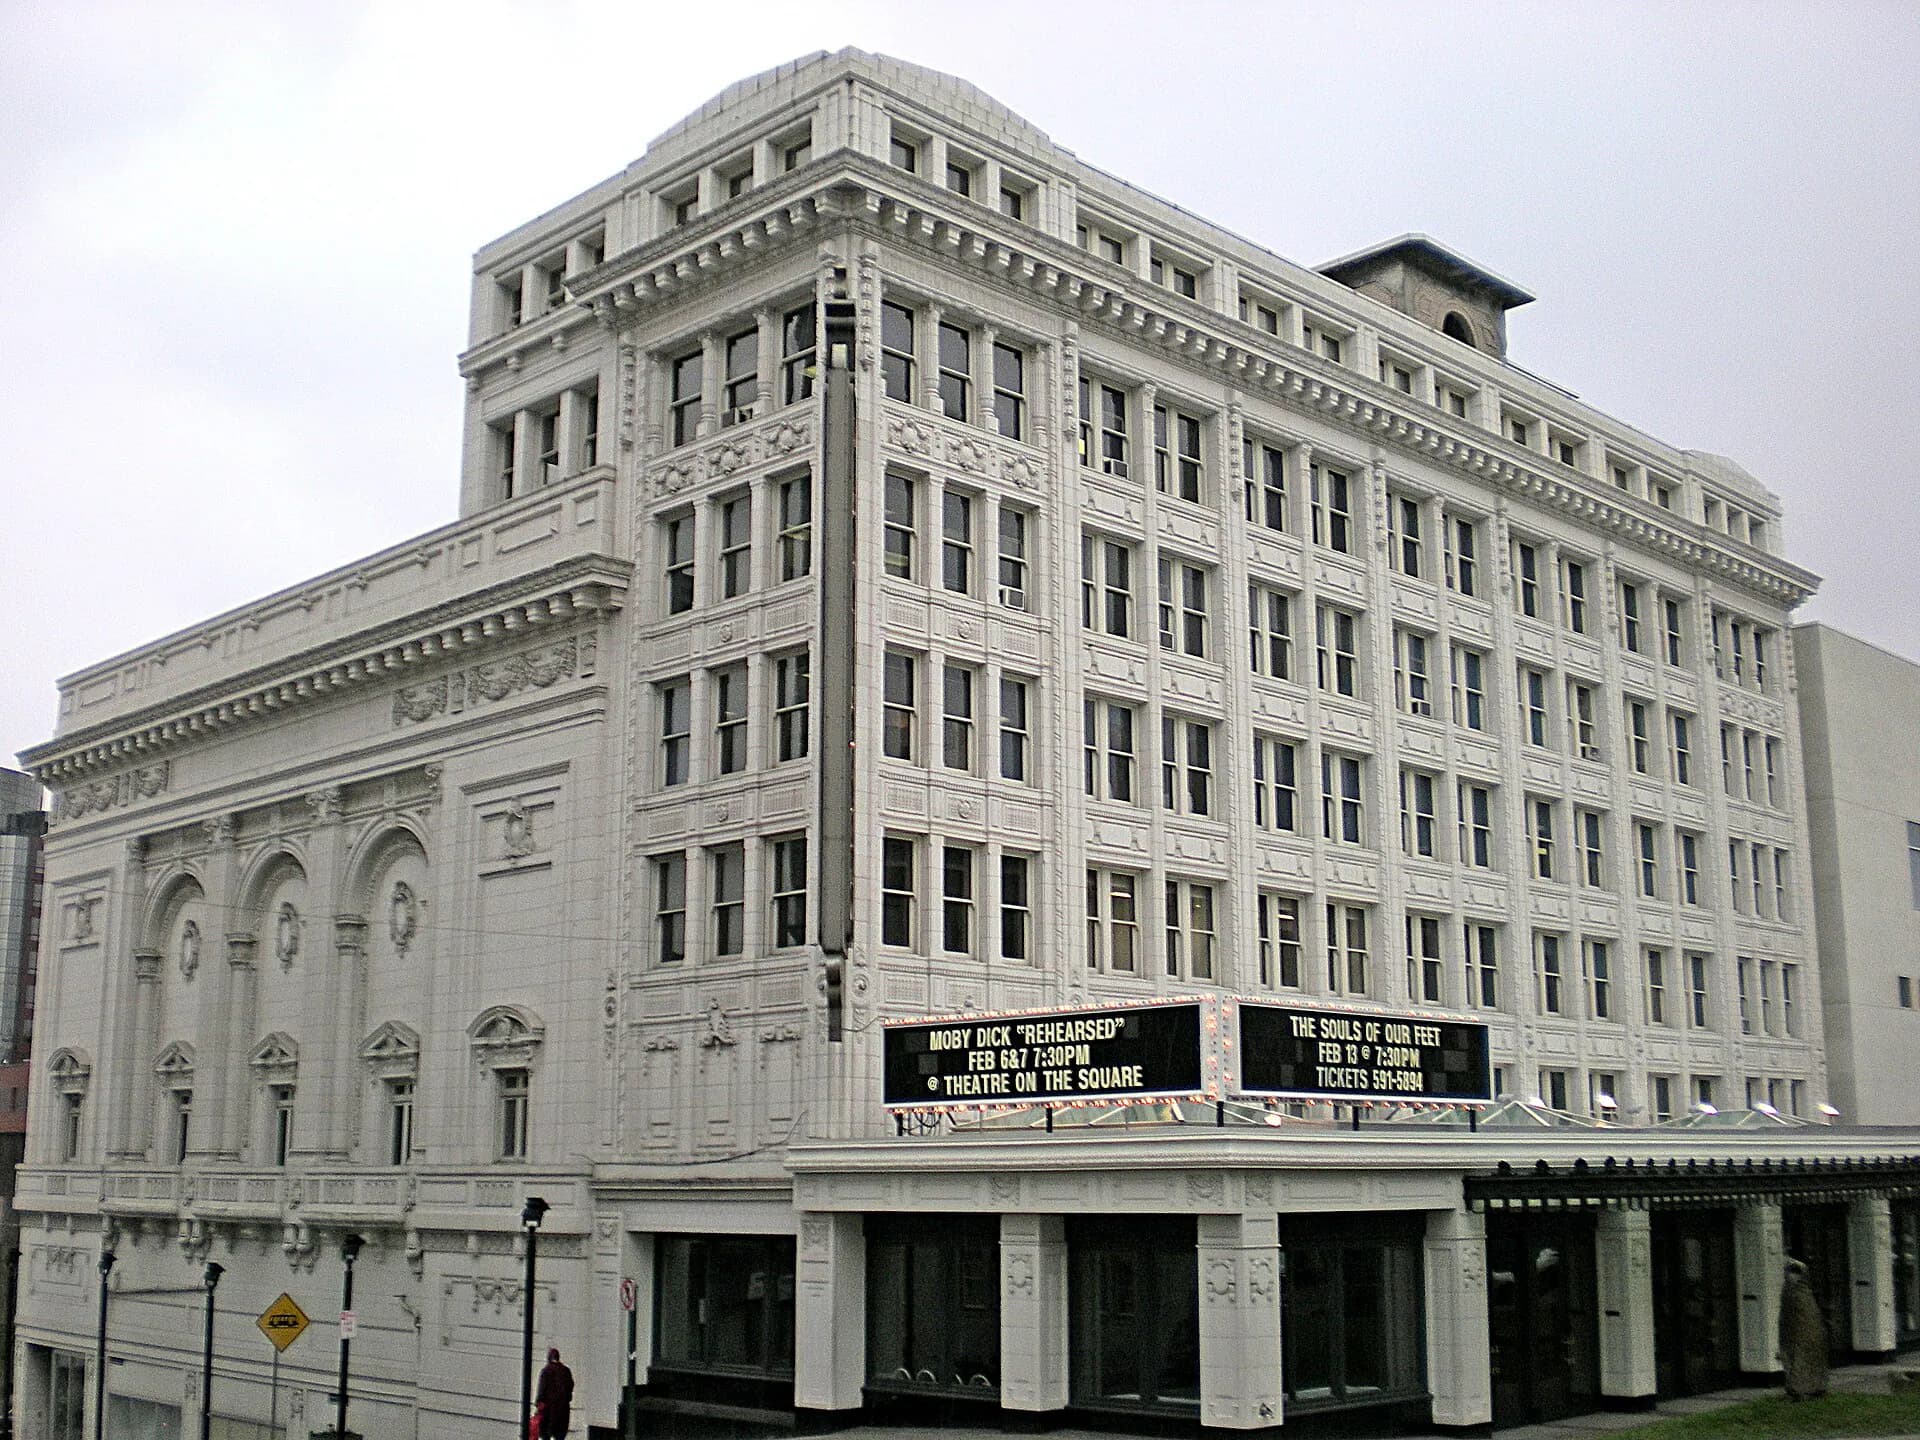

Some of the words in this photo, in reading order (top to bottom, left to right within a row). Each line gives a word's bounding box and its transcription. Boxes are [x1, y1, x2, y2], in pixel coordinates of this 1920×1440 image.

[929, 1028, 972, 1051] MOBY
[976, 1025, 1012, 1048] DICK
[1289, 1015, 1317, 1038] THE
[1320, 1017, 1362, 1041] SOULS
[1365, 1021, 1381, 1043] OF
[1385, 1023, 1412, 1045] OUR
[1413, 1024, 1442, 1047] FEET
[968, 1050, 996, 1072] FEB
[1000, 1047, 1029, 1070] 6&7
[1033, 1044, 1091, 1068] 7:30PM
[1318, 1041, 1343, 1064] FEB
[1345, 1043, 1359, 1065] 13
[1361, 1045, 1371, 1060] @
[1375, 1045, 1421, 1069] 7:30PM
[927, 1076, 939, 1091] @
[943, 1072, 1011, 1096] THEATRE
[1015, 1071, 1038, 1093] ON
[1042, 1069, 1073, 1091] THE
[1078, 1064, 1144, 1090] SQUARE
[1316, 1066, 1369, 1090] TICKETS
[1372, 1069, 1424, 1092] 591-5894
